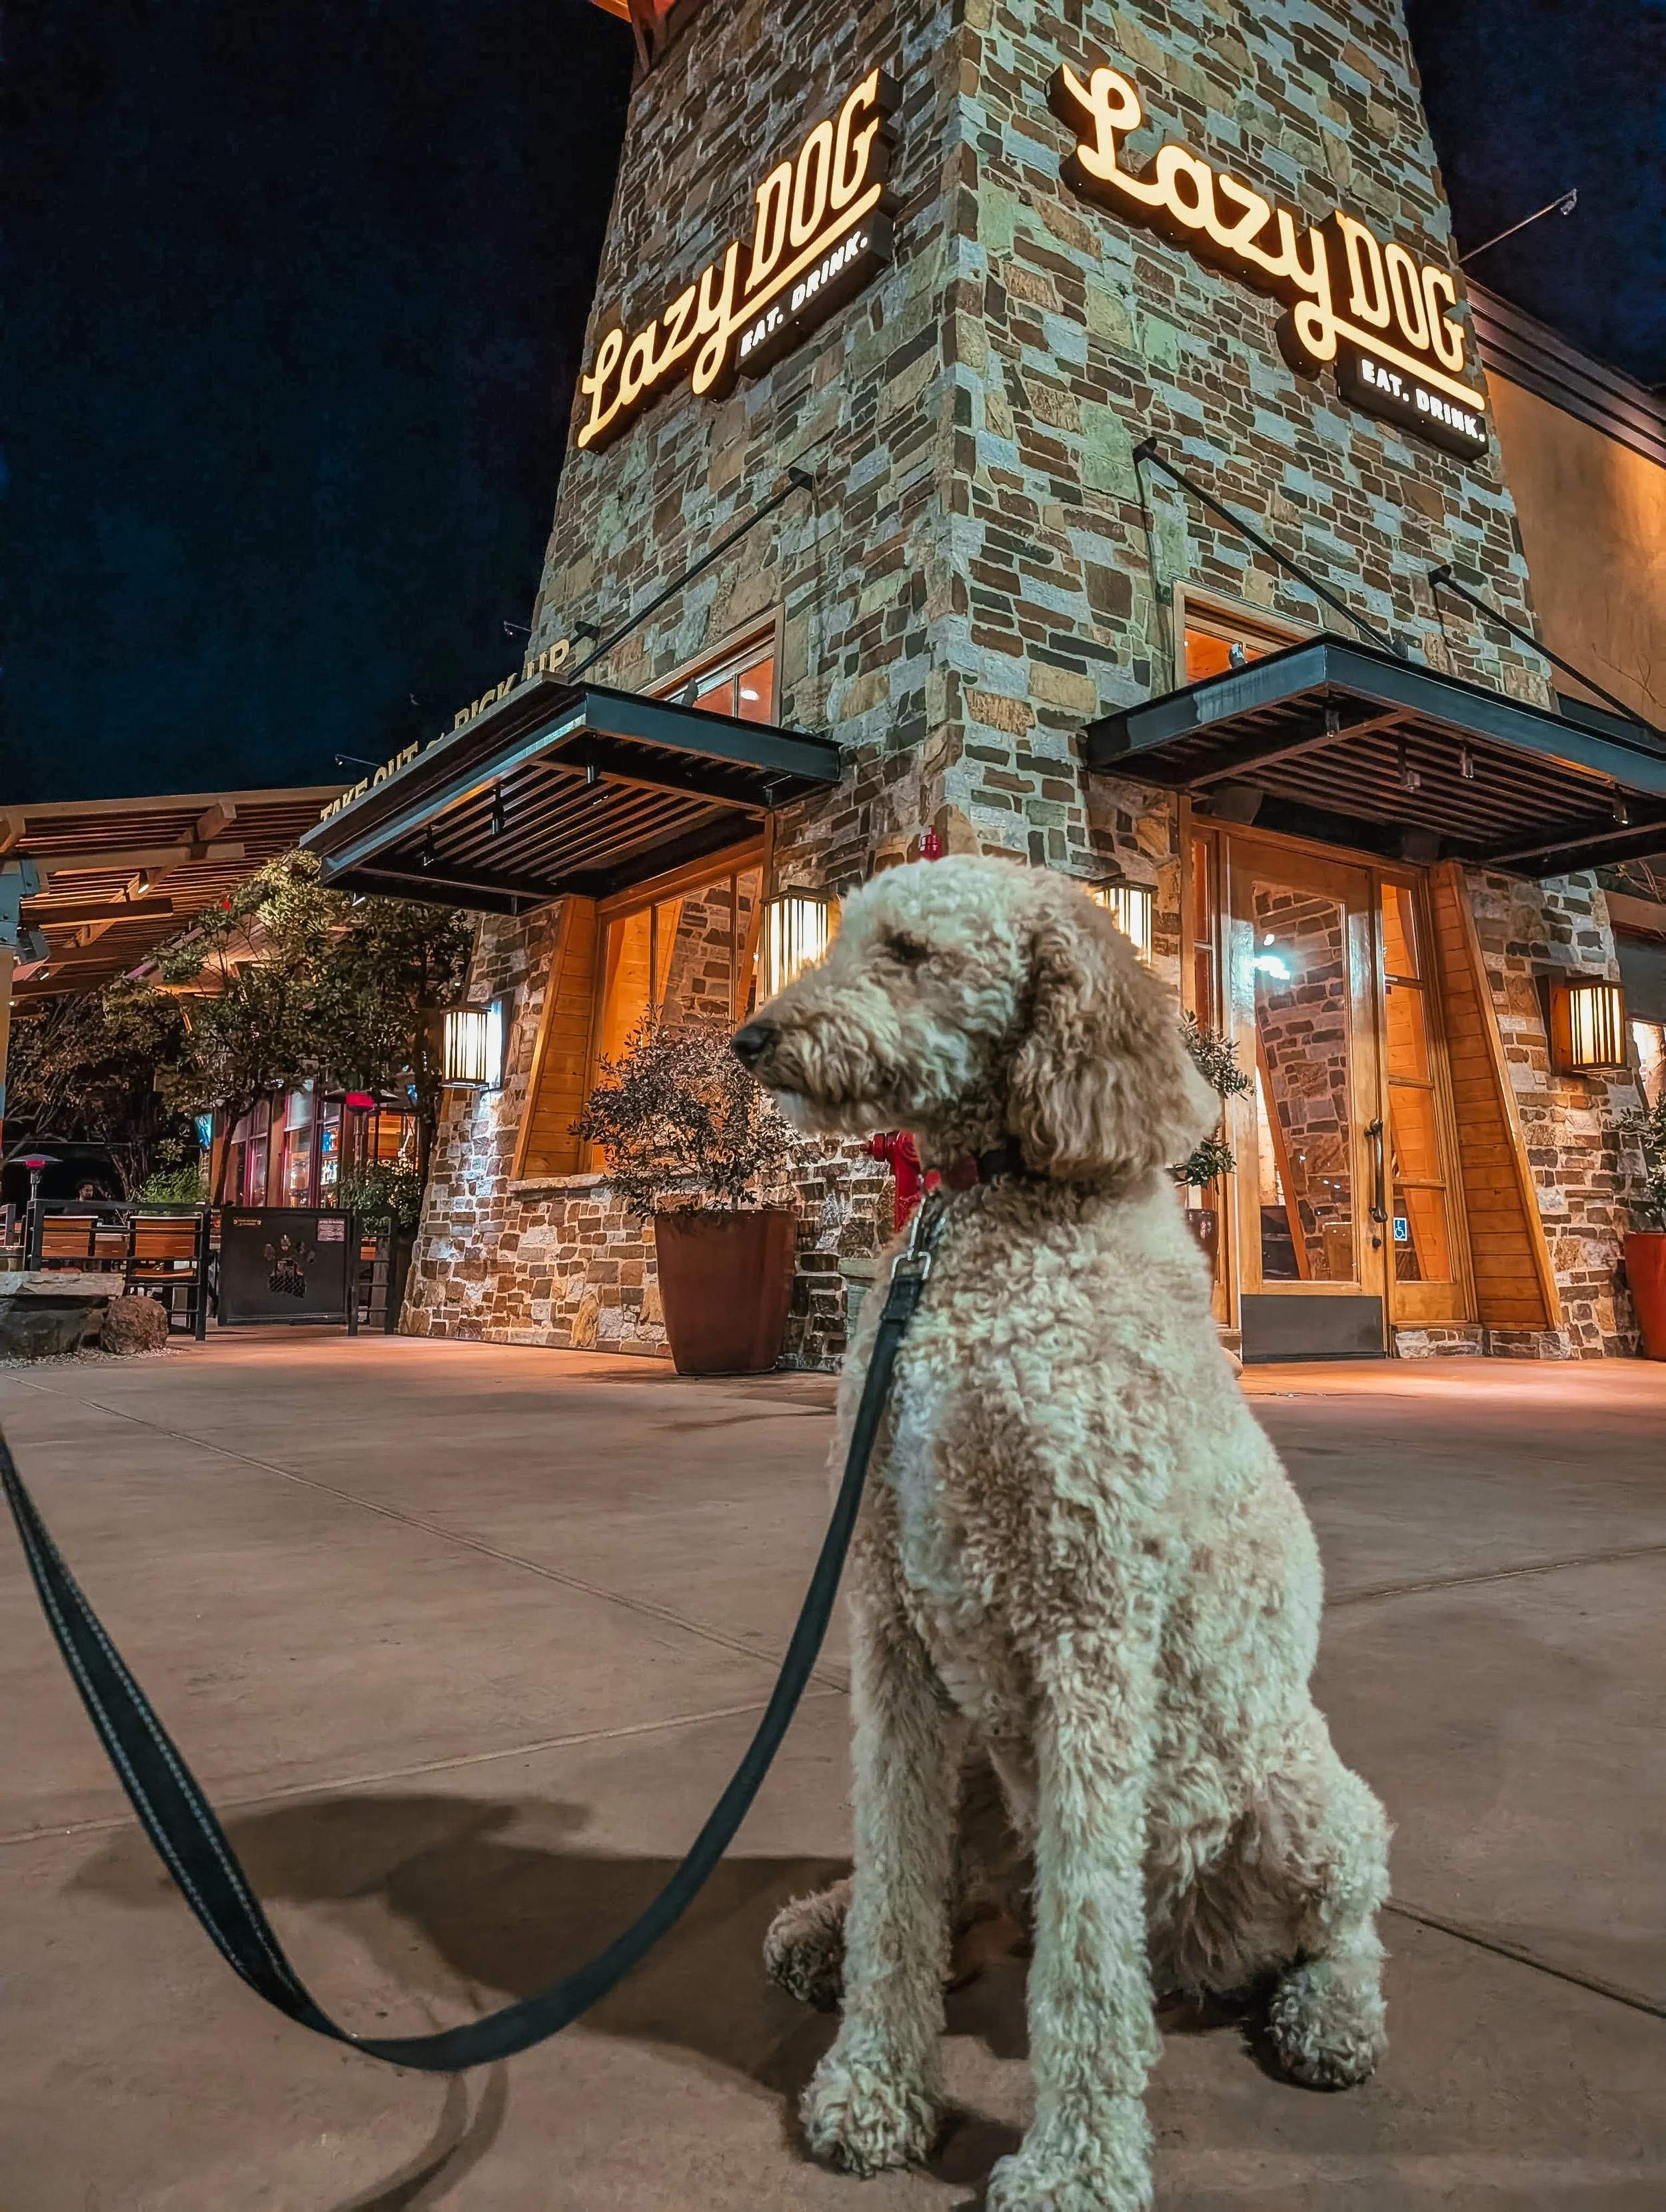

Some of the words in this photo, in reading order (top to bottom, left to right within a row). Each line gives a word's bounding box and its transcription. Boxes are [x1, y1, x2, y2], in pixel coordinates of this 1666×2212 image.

[578, 241, 739, 449] Lazy
[745, 68, 879, 296] DOG
[1062, 63, 1337, 360] Lazy
[1335, 211, 1465, 372] DOG
[740, 306, 784, 357] EAT.
[790, 231, 868, 311] DRINK.
[1361, 358, 1409, 402] EAT.
[1415, 388, 1485, 442] DRINK.
[321, 777, 369, 822] TAKE
